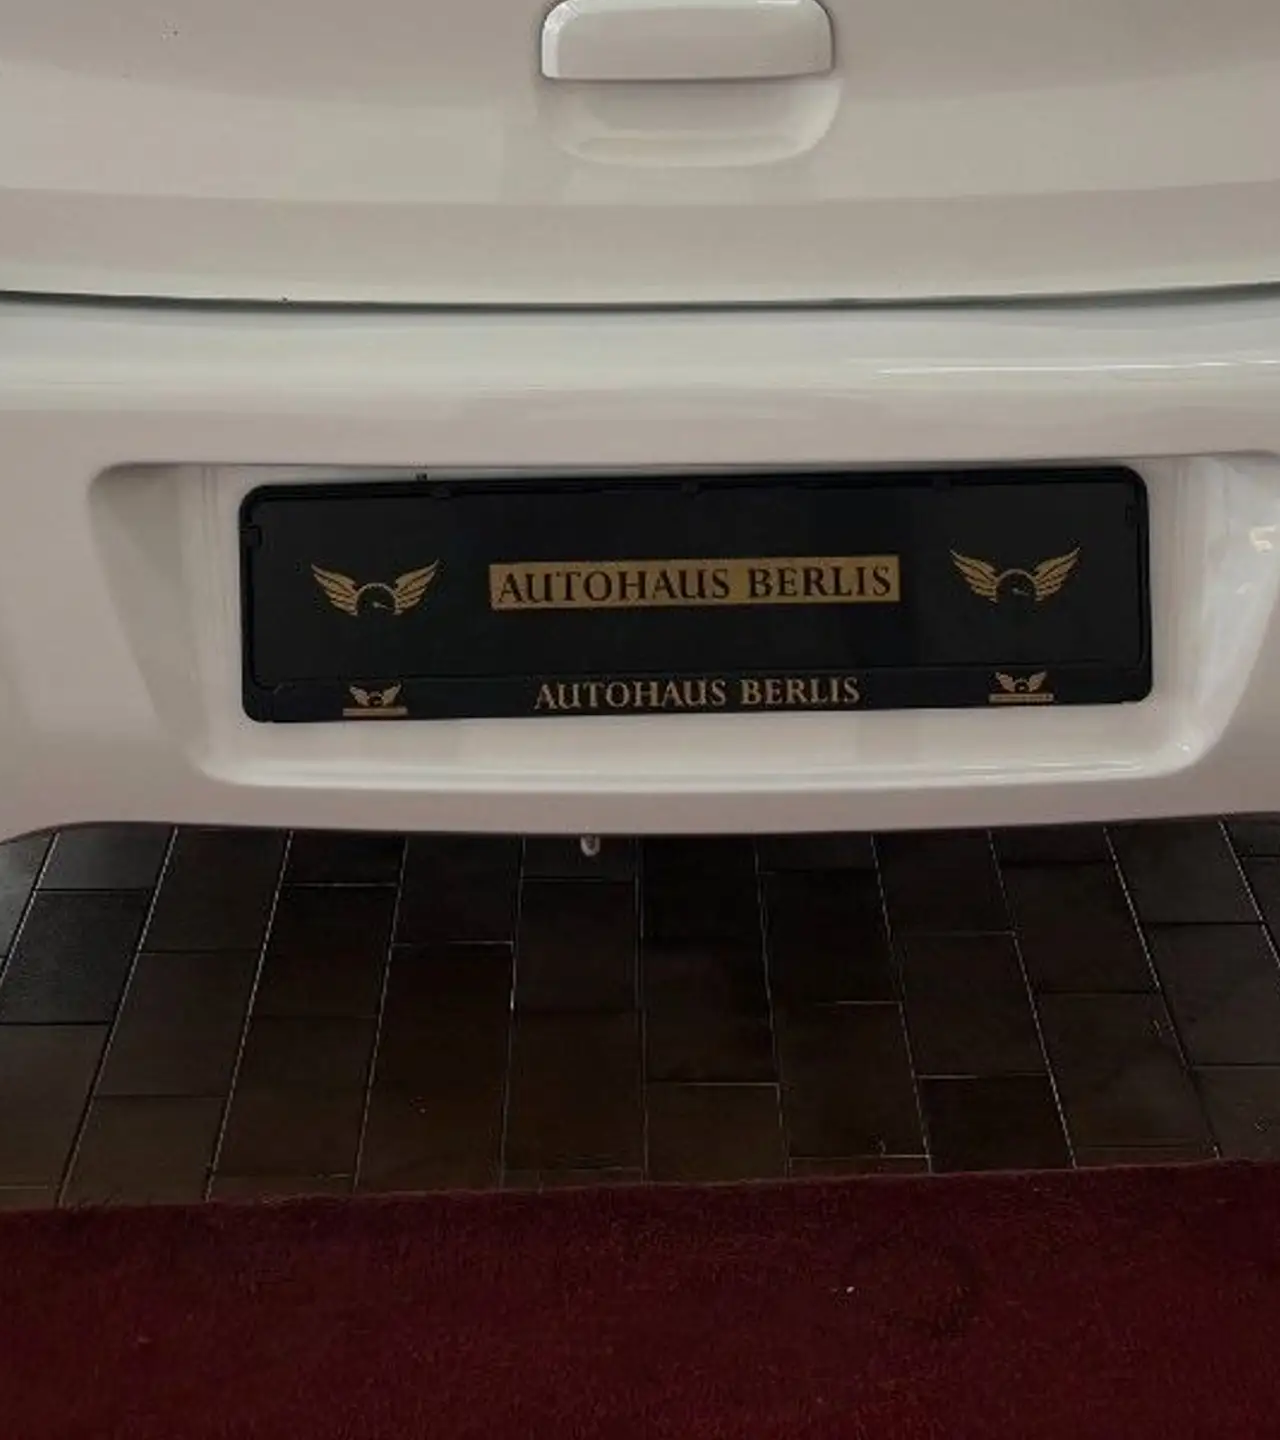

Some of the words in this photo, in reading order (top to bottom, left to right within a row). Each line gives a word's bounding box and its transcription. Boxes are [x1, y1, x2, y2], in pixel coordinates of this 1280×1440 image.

[499, 569, 730, 604] AUTOHAUS
[748, 566, 892, 599] BERLIS
[535, 679, 726, 709] AUTOHAUS
[741, 676, 860, 704] BERLIS
